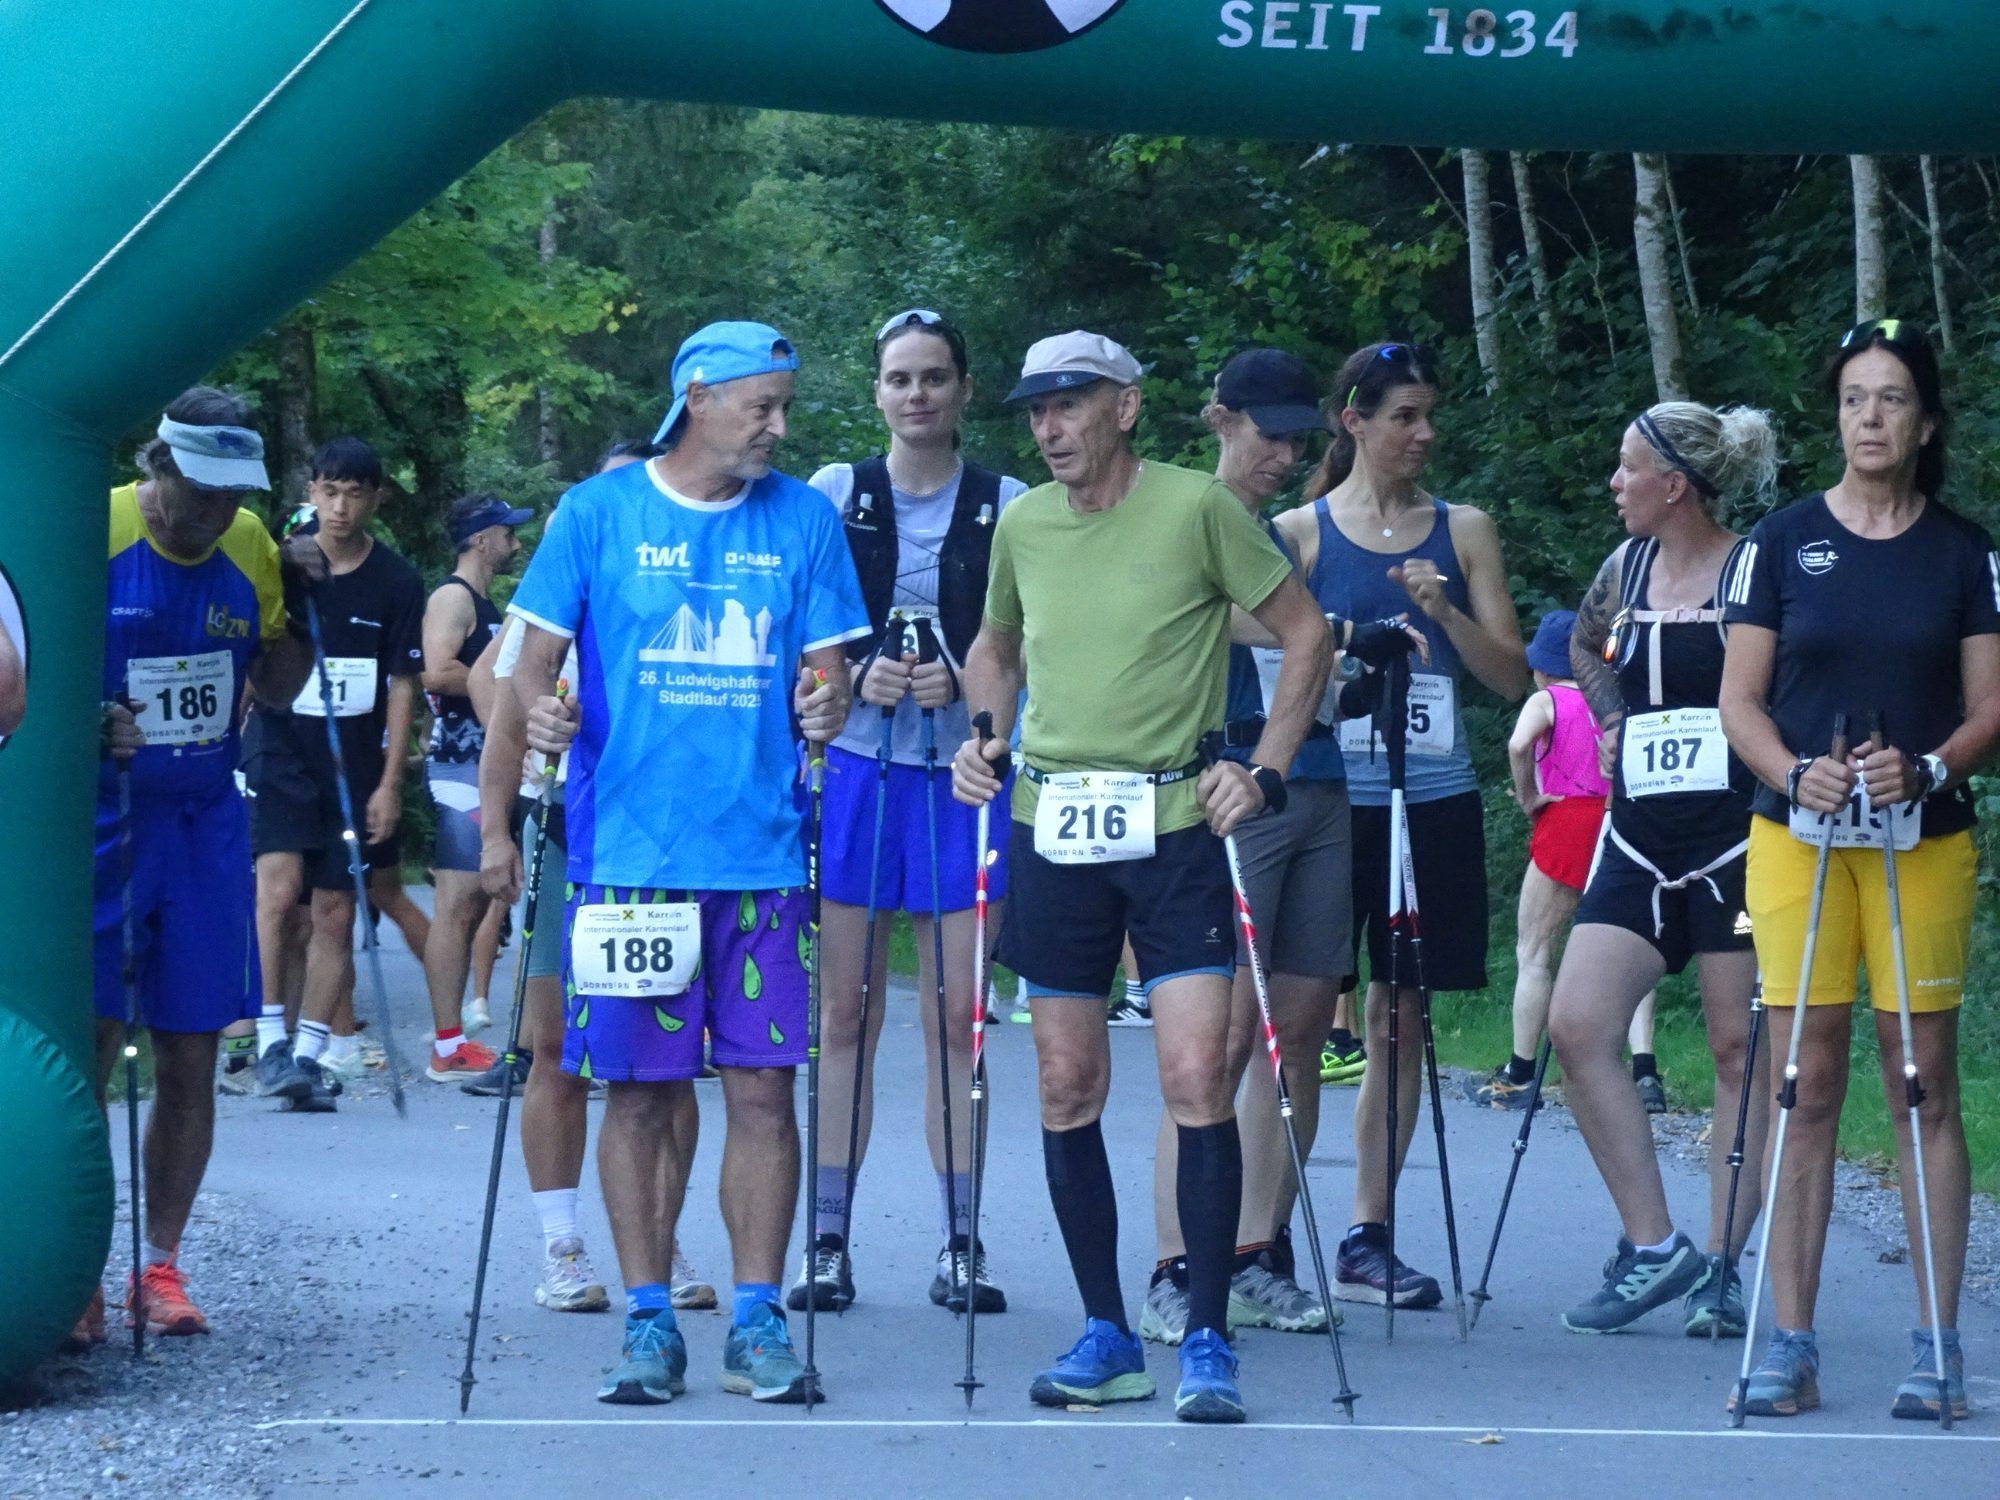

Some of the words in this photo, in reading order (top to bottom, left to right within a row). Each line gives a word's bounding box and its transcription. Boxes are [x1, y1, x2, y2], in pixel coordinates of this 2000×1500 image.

[1217, 0, 1381, 50] SEIT
[1424, 8, 1579, 58] 1834
[635, 542, 691, 567] twl
[638, 670, 661, 685] 26.
[156, 684, 217, 721] 186
[659, 690, 728, 706] Stadtlauf
[1643, 737, 1702, 773] 187
[1160, 770, 1184, 784] AUW
[1100, 793, 1144, 801] Karrenlauf
[1057, 804, 1127, 841] 216
[583, 926, 643, 934] Internationaler
[645, 924, 689, 933] Karrenlauf
[600, 936, 674, 974] 188
